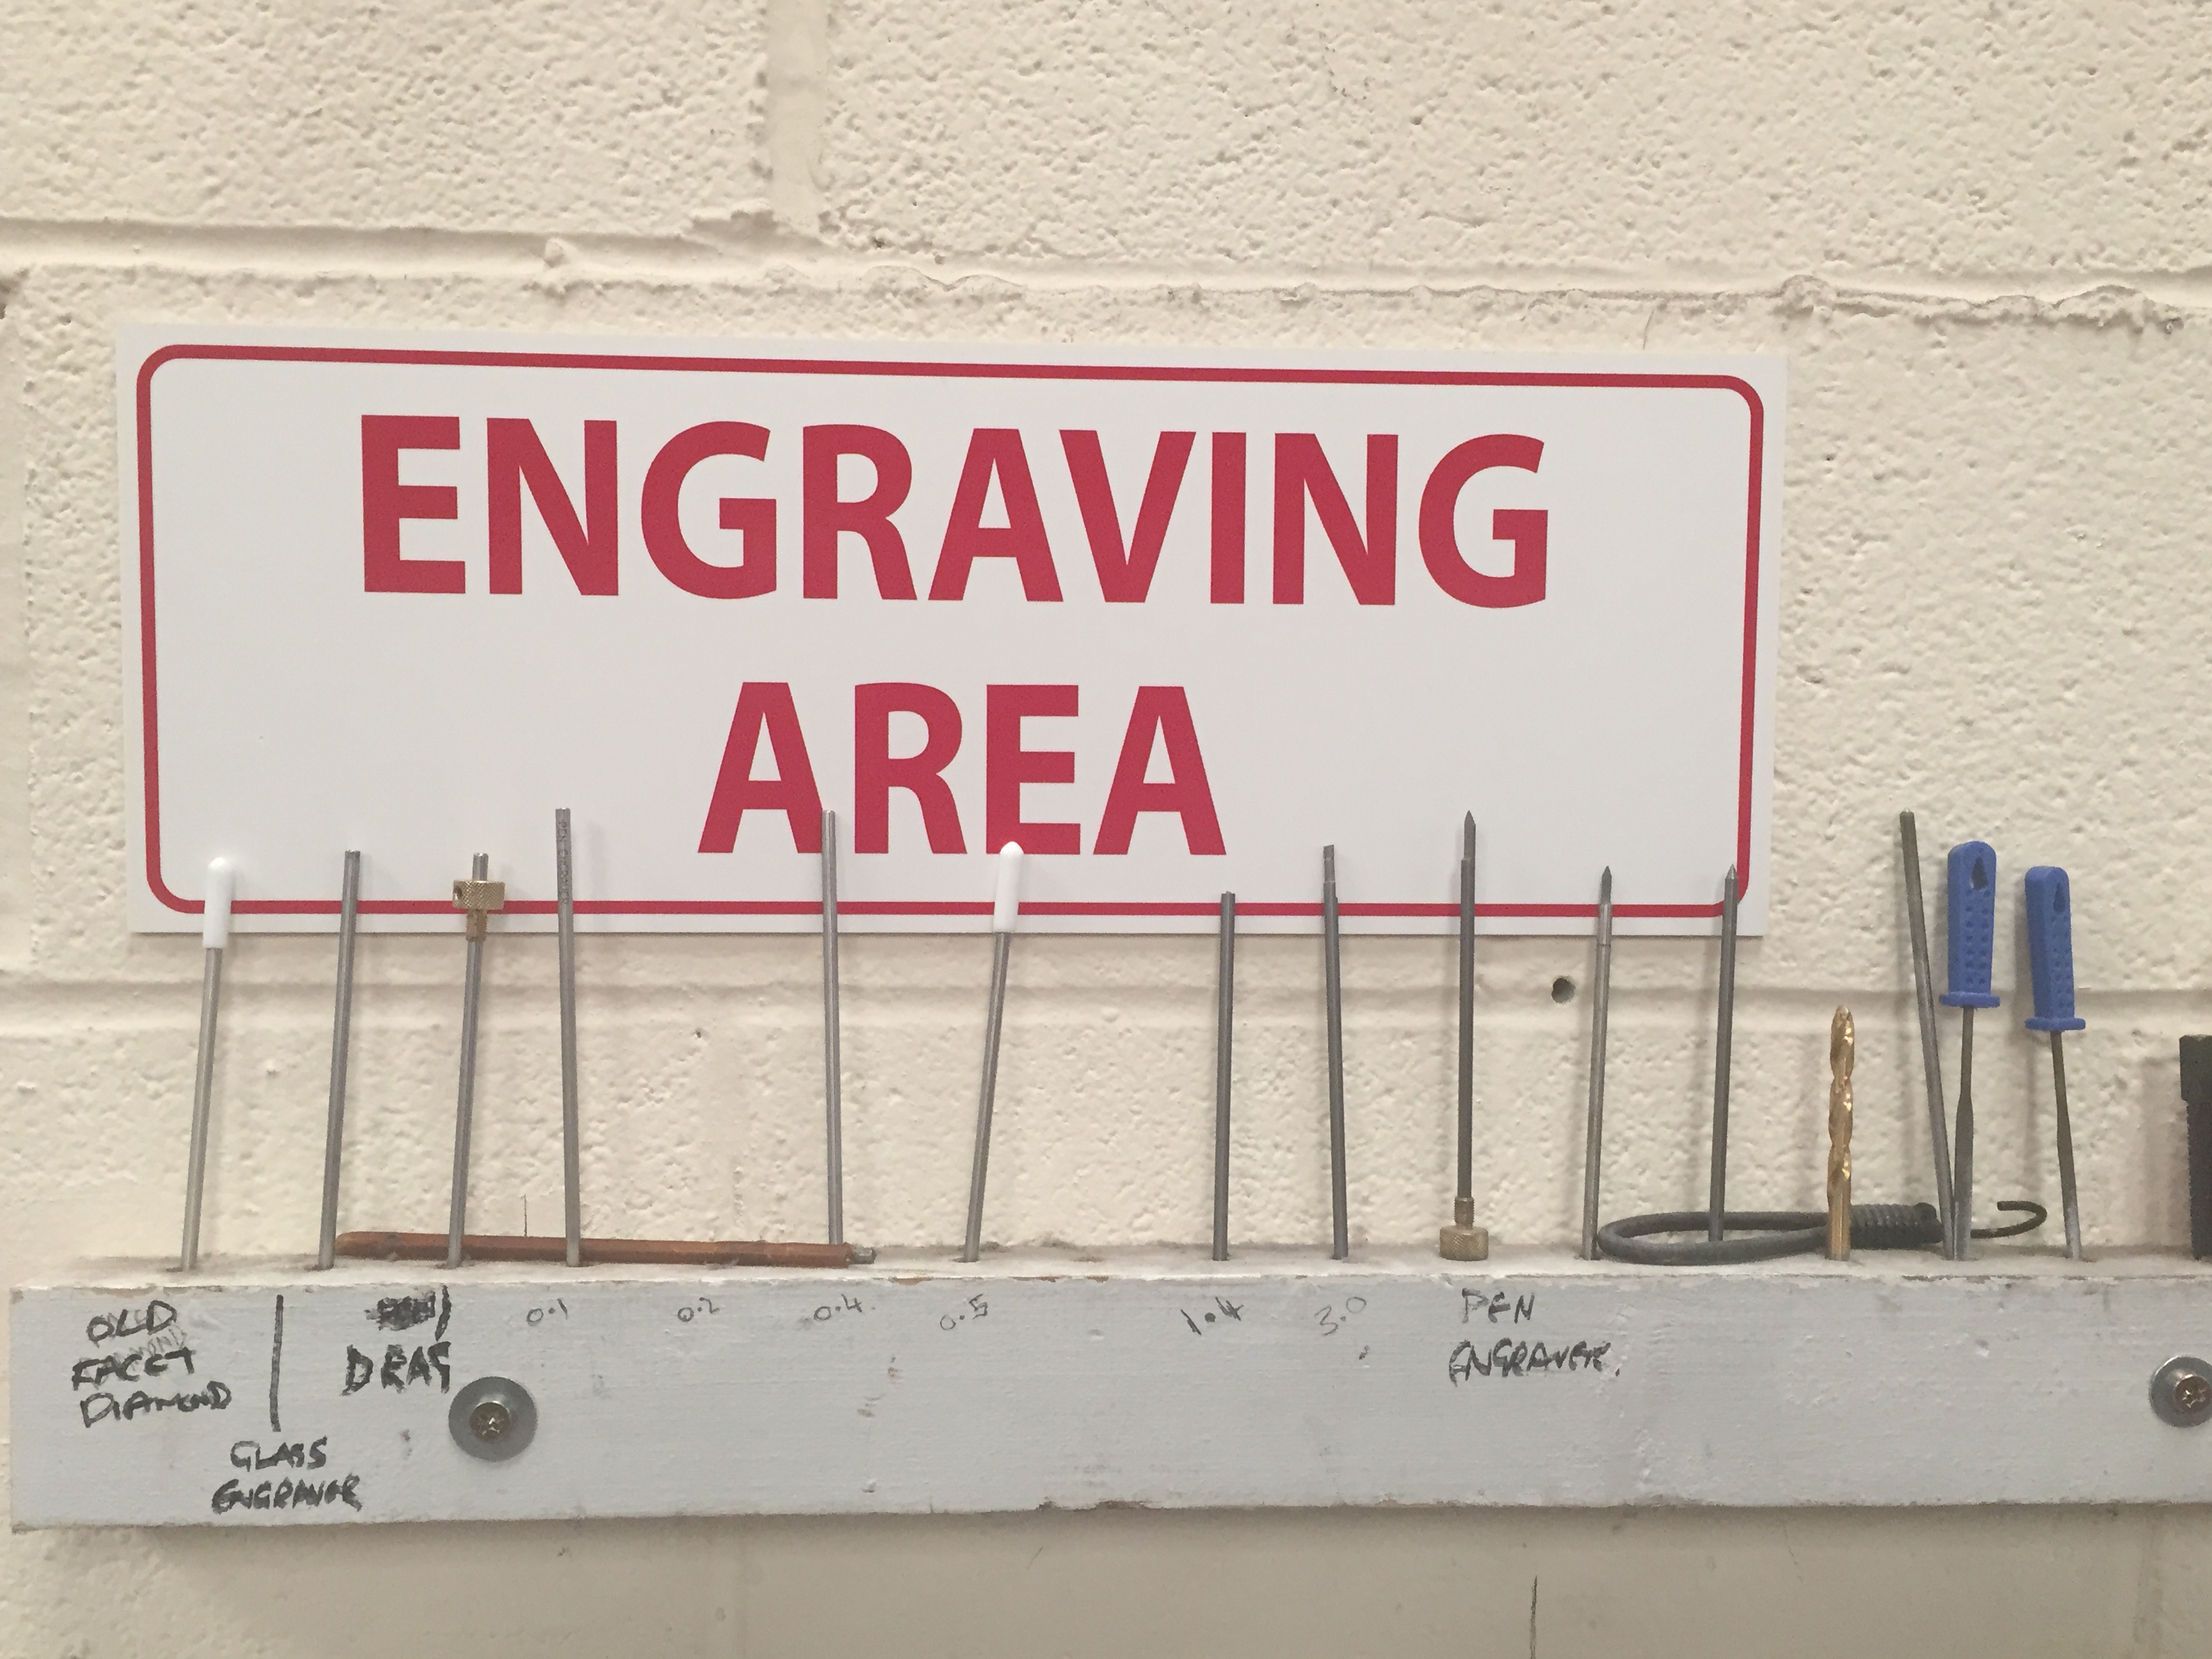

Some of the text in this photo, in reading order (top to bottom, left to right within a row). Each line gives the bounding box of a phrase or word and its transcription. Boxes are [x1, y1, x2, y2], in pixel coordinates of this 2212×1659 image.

[362, 415, 1548, 608] ENGRAVING
[699, 682, 1226, 855] AREA
[86, 1299, 178, 1348] OLD
[526, 1297, 569, 1327] 0.1
[677, 1296, 720, 1323] 0.2
[813, 1293, 863, 1322] 0.4
[939, 1292, 989, 1331] 0.5
[1180, 1296, 1244, 1336] 1.4
[1313, 1296, 1368, 1336] 3.0
[1461, 1288, 1536, 1324] PEN
[79, 1380, 232, 1429] DIAMOND
[230, 1435, 328, 1473] GLASS
